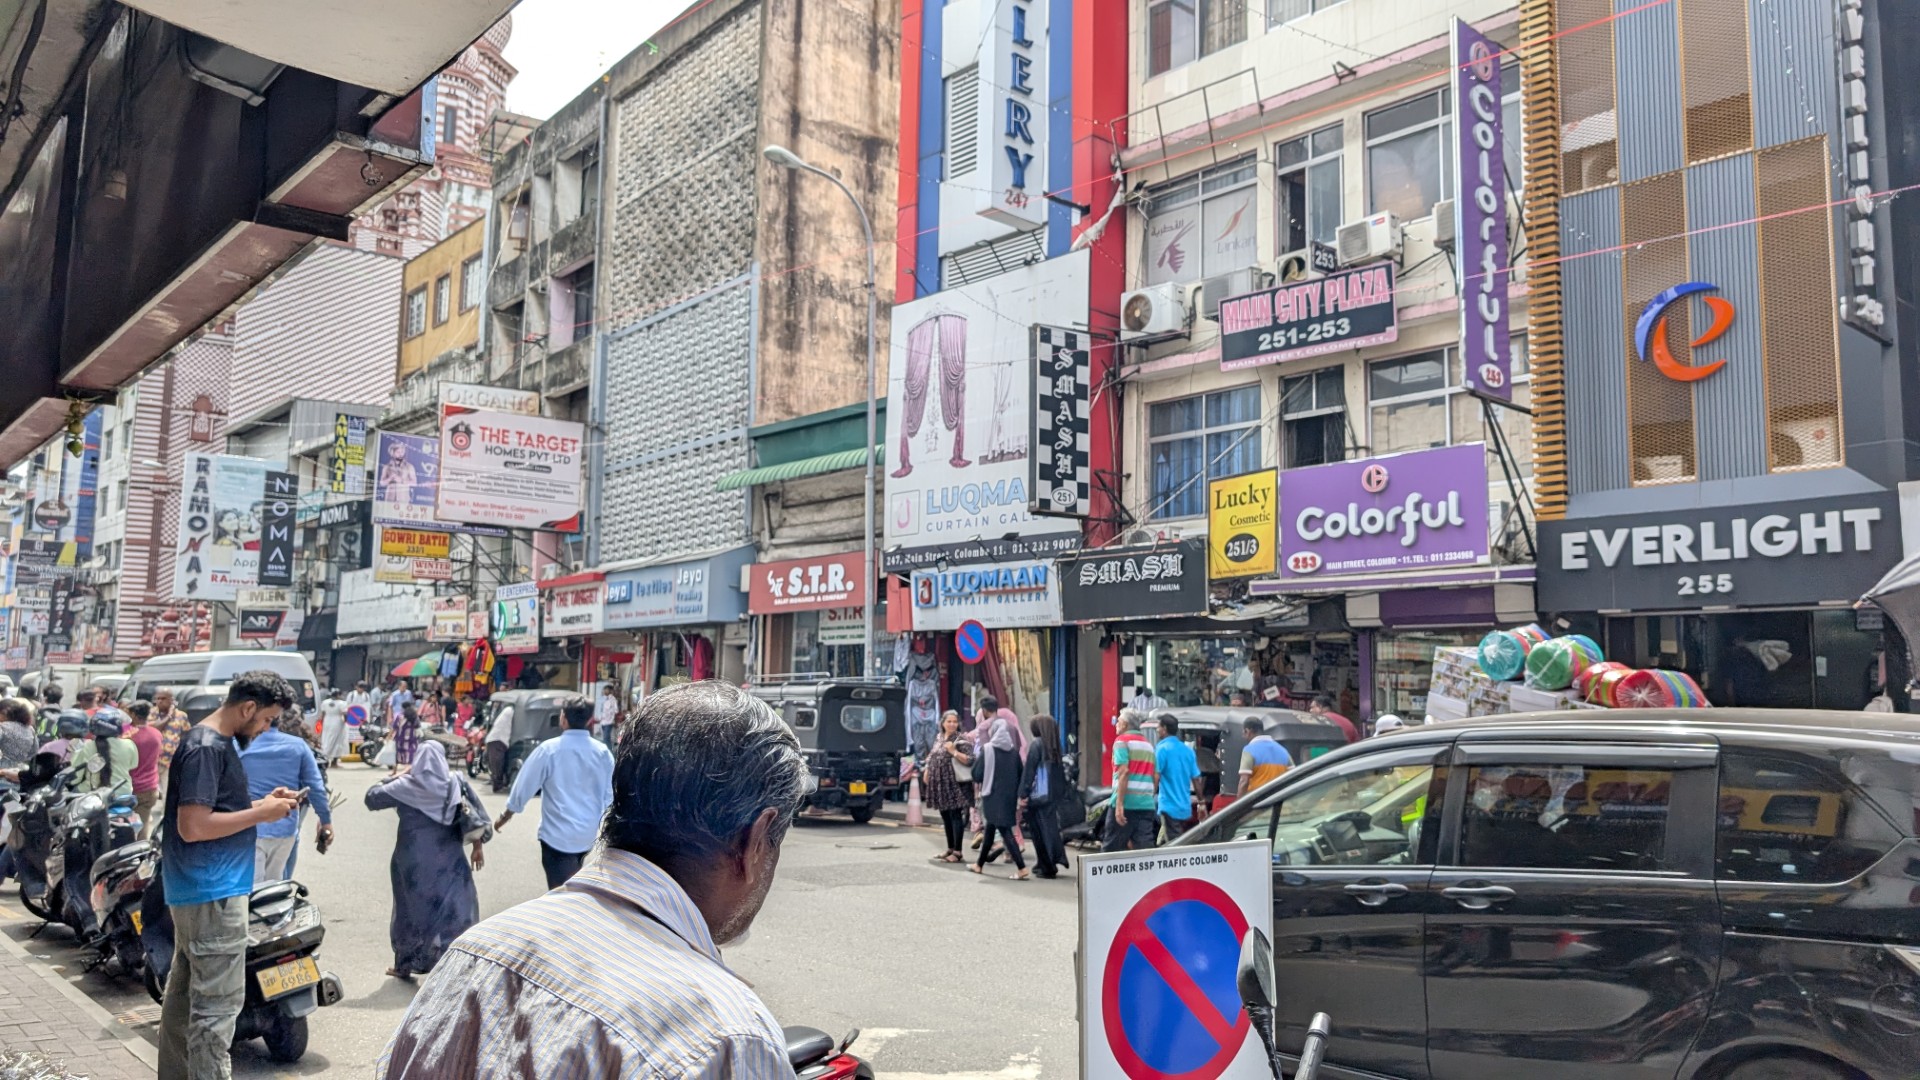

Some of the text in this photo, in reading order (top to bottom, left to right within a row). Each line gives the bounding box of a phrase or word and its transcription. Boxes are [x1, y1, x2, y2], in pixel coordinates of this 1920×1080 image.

[1004, 0, 1034, 189] LERY
[1842, 0, 1875, 286] VERLIGHT
[1004, 188, 1029, 209] 247
[1469, 84, 1499, 361] Colorful
[1315, 251, 1334, 268] 253
[1223, 268, 1390, 334] MAIN CITY PLAZA
[1258, 317, 1350, 350] 251-253
[1486, 368, 1501, 385] 253
[1053, 348, 1076, 478] SMASH
[479, 425, 579, 453] THE TARGET
[485, 445, 571, 465] HOMES PVT LTD
[1056, 491, 1072, 503] 251
[1215, 483, 1271, 511] Lucky
[179, 457, 211, 595] RAMONAS
[269, 478, 290, 563] NOMA
[320, 504, 348, 527] NOMA
[926, 516, 989, 532] CURTAIN
[1230, 511, 1271, 527] Cosmetic
[1296, 491, 1464, 546] Colorful
[384, 531, 448, 547] GOWRI BATIK
[1032, 541, 1048, 551] 232
[1053, 538, 1076, 549] 9007
[1227, 539, 1257, 558] 251/3
[1561, 507, 1881, 570] EVERLIGHT
[1079, 554, 1183, 586] SMASH
[1292, 556, 1317, 569] 253
[1326, 562, 1342, 570] MAIN
[1343, 561, 1366, 569] STREET,
[1367, 557, 1396, 567] COLOMBO
[677, 568, 703, 587] Jeya
[787, 563, 854, 596] S.T.R.
[940, 564, 1048, 592] LUQMAAN
[1150, 584, 1180, 592] PREMIUM
[1677, 574, 1733, 595] 255
[942, 591, 1049, 606] CURTAIN GALLERY
[1091, 854, 1229, 876] BY ORDER SSP TRAFIC COLOMBO
